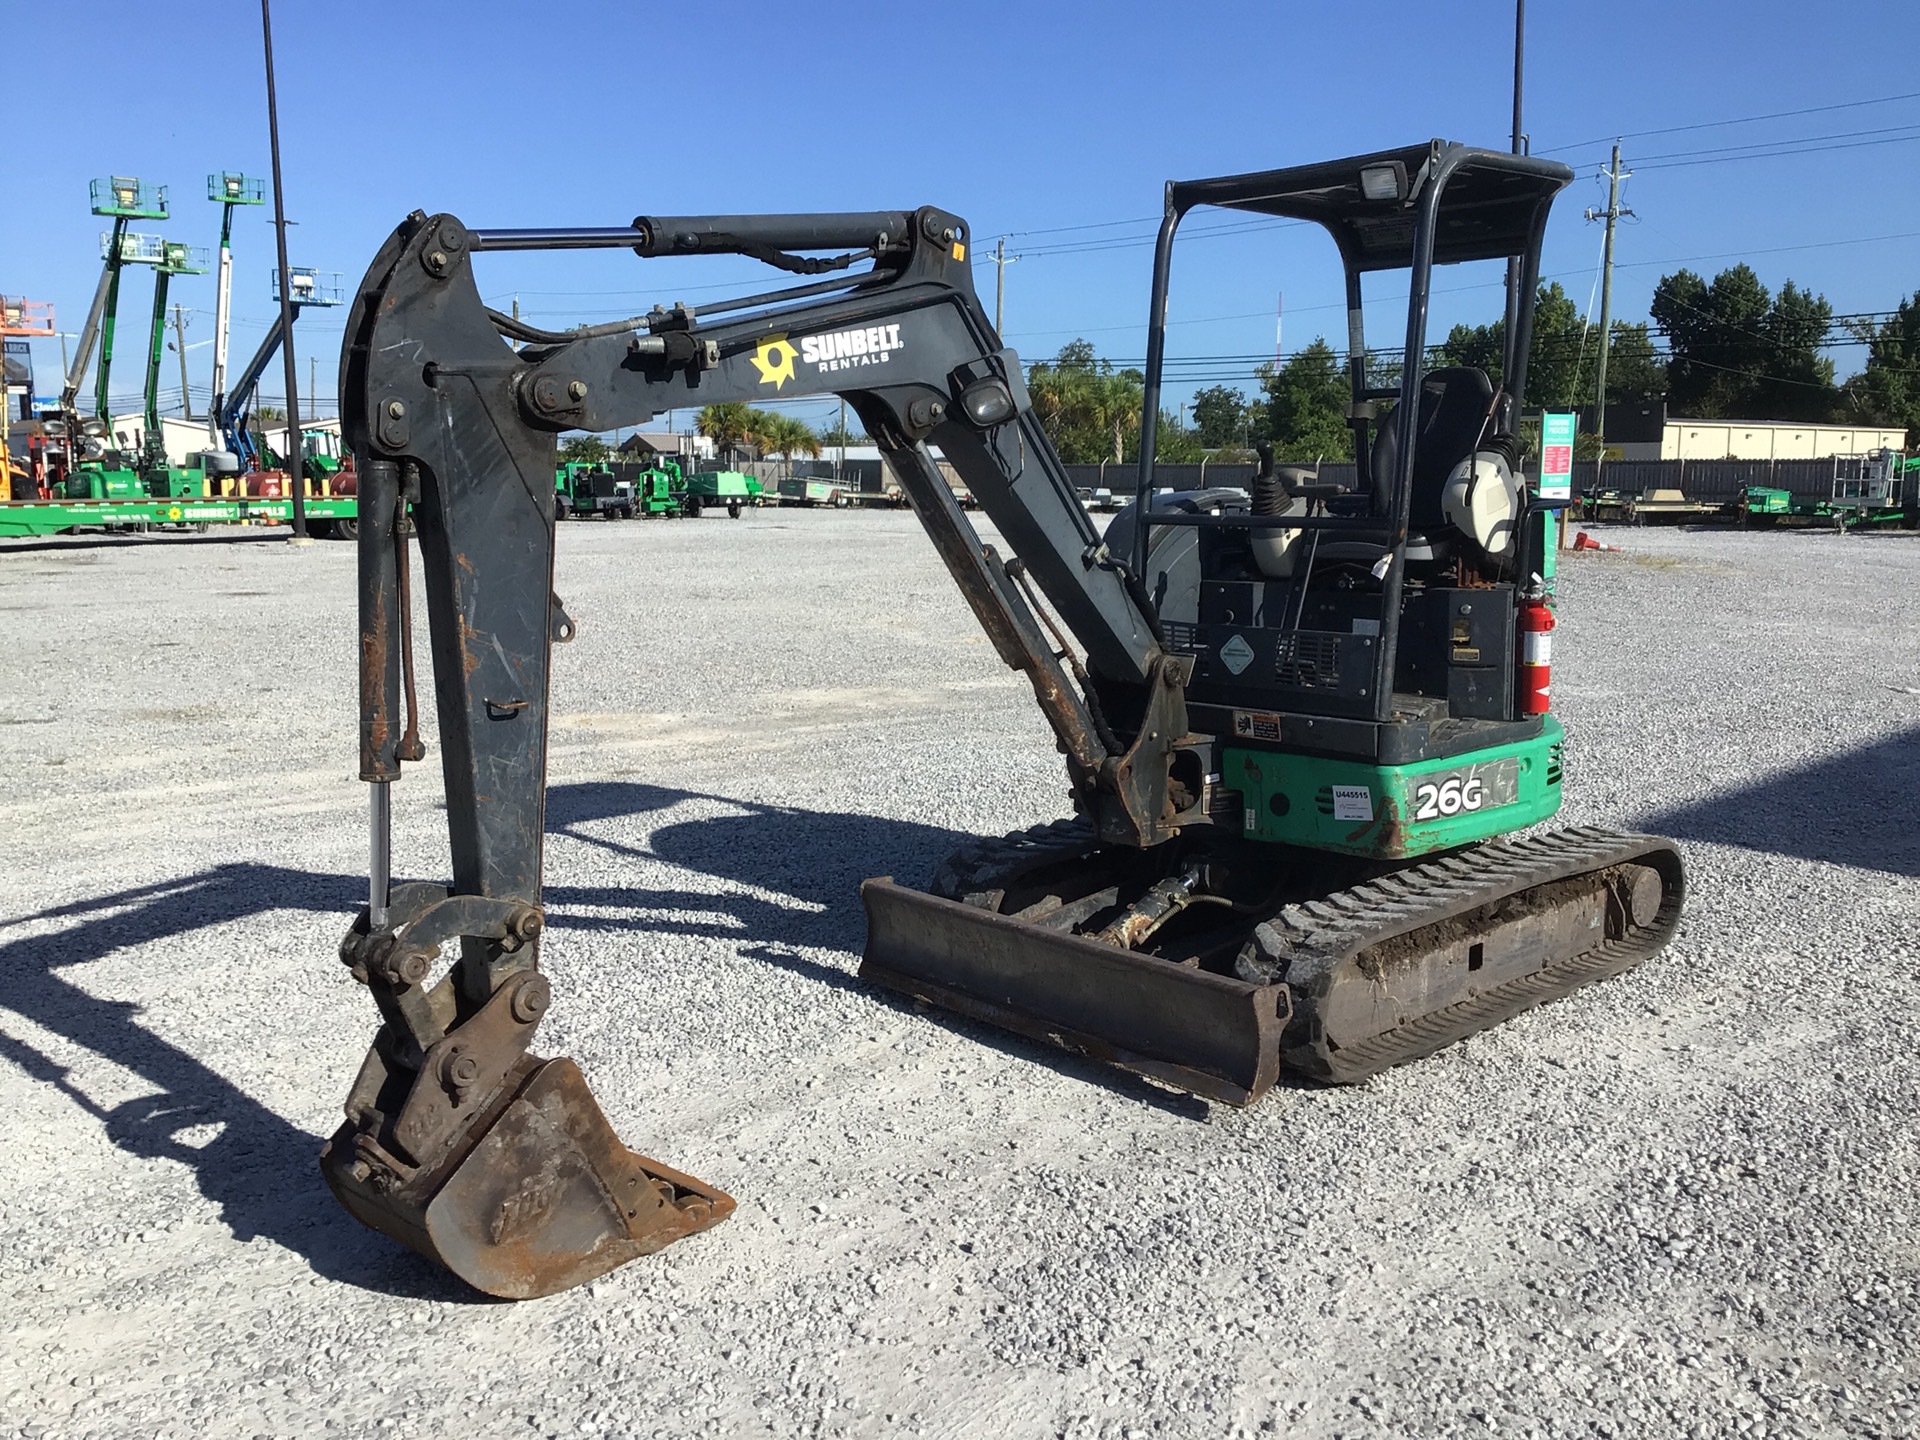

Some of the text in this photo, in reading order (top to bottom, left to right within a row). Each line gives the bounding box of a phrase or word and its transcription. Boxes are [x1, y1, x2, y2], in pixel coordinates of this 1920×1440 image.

[801, 324, 900, 364] SUNBELT
[819, 352, 890, 373] RENTALS
[1336, 791, 1369, 799] U445515
[1416, 778, 1482, 822] 26G
